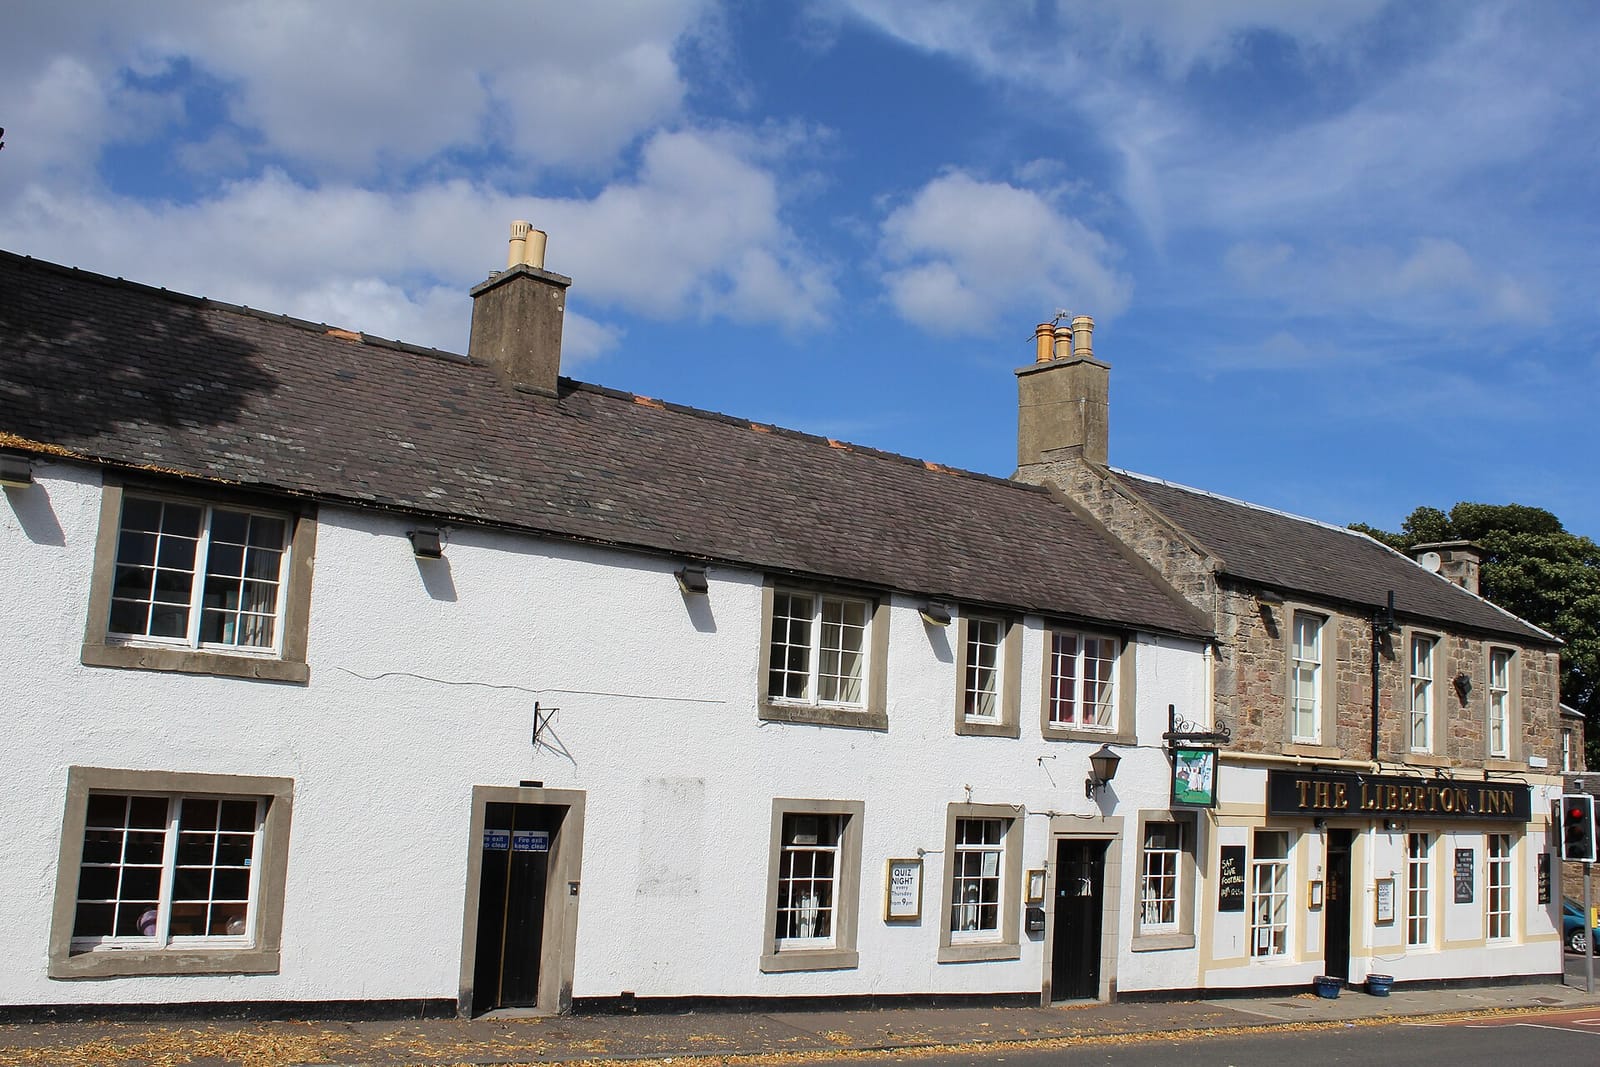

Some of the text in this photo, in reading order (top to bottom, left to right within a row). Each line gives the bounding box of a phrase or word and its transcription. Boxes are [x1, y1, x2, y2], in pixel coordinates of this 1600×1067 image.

[1296, 780, 1514, 814] THE LIBERTON INN
[891, 877, 914, 885] NIGHT
